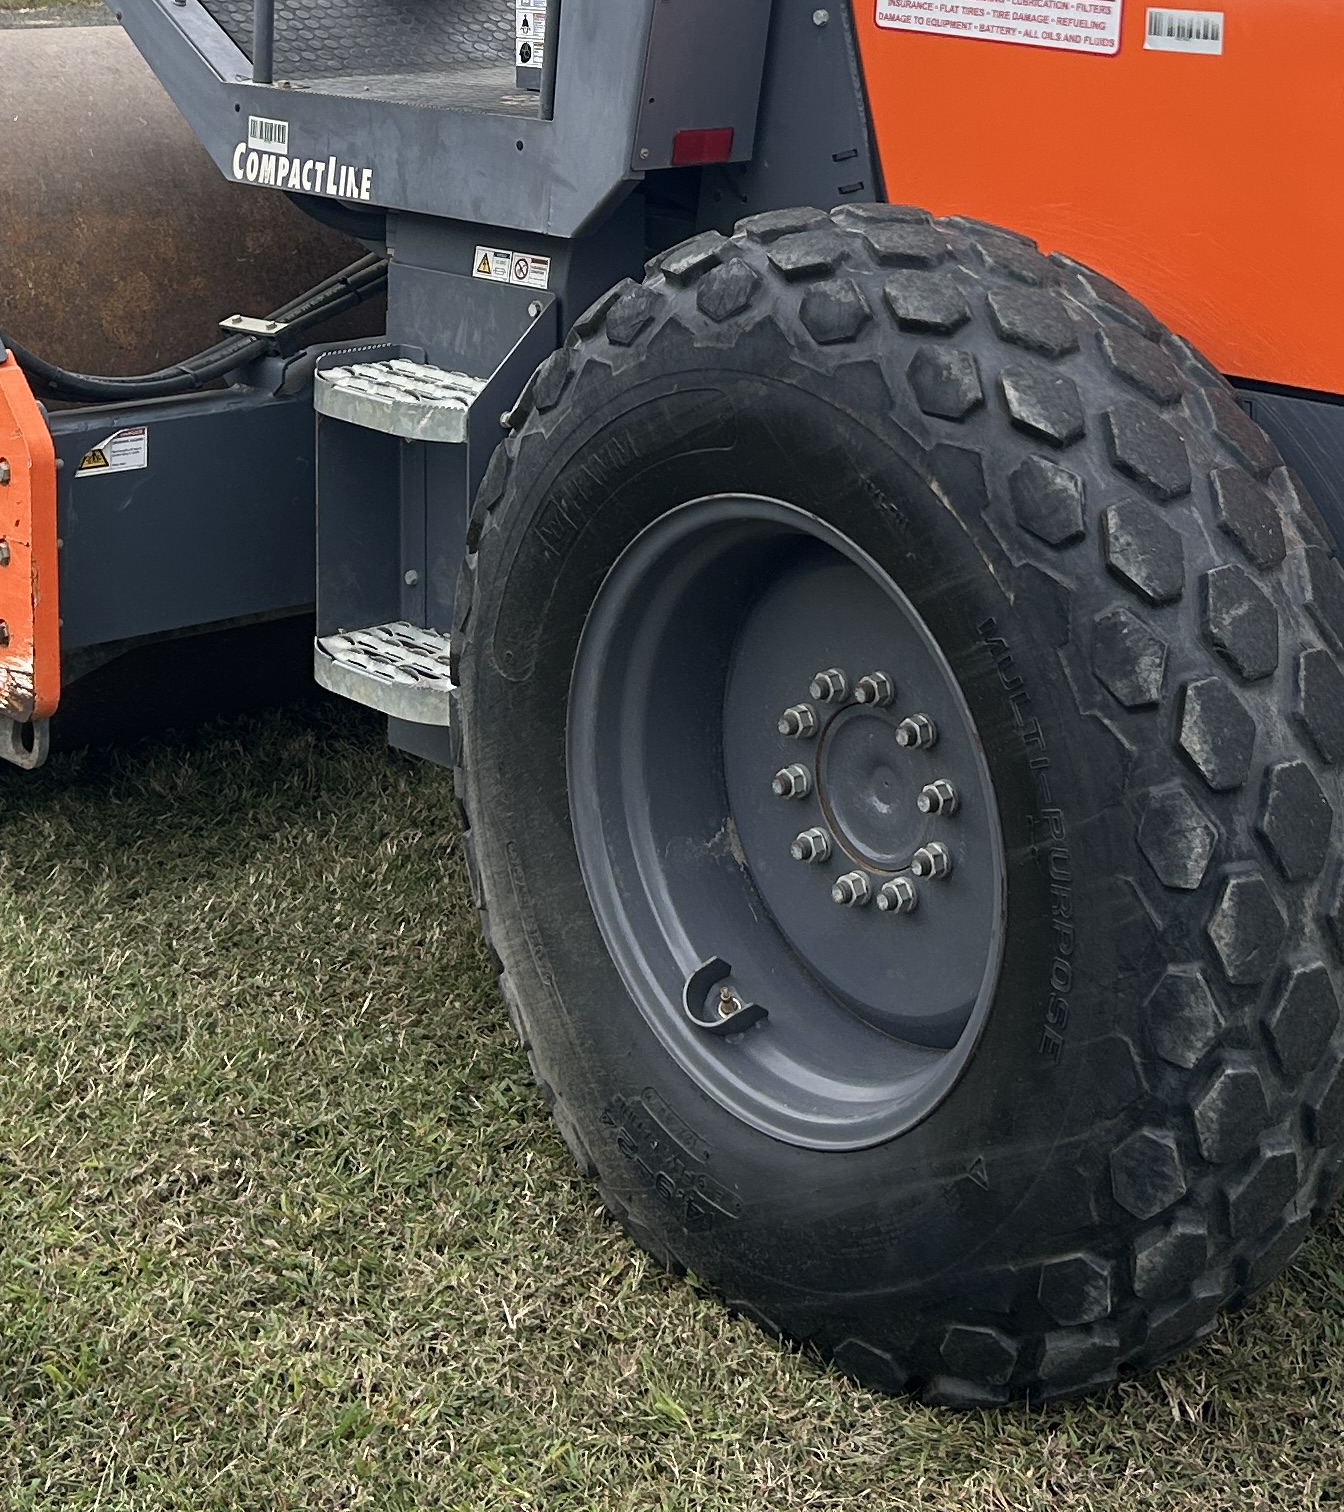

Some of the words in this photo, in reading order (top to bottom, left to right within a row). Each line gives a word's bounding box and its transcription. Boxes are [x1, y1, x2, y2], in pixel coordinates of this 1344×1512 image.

[939, 3, 959, 14] FLAT
[961, 5, 985, 17] TIRES
[991, 8, 1010, 19] TIRE
[1012, 11, 1049, 24] DAMAGE
[1056, 16, 1106, 31] REFUELING
[1076, 2, 1112, 15] FILTERS
[878, 11, 912, 24] DAMAGE
[913, 15, 924, 25] TO
[978, 23, 1016, 36] BATTERY
[1022, 28, 1039, 39] ALL
[1041, 31, 1061, 42] OILS
[1062, 33, 1081, 44] AND
[1083, 35, 1115, 48] FLUIDS
[978, 616, 1074, 1061] MULTI-PURPOSE
